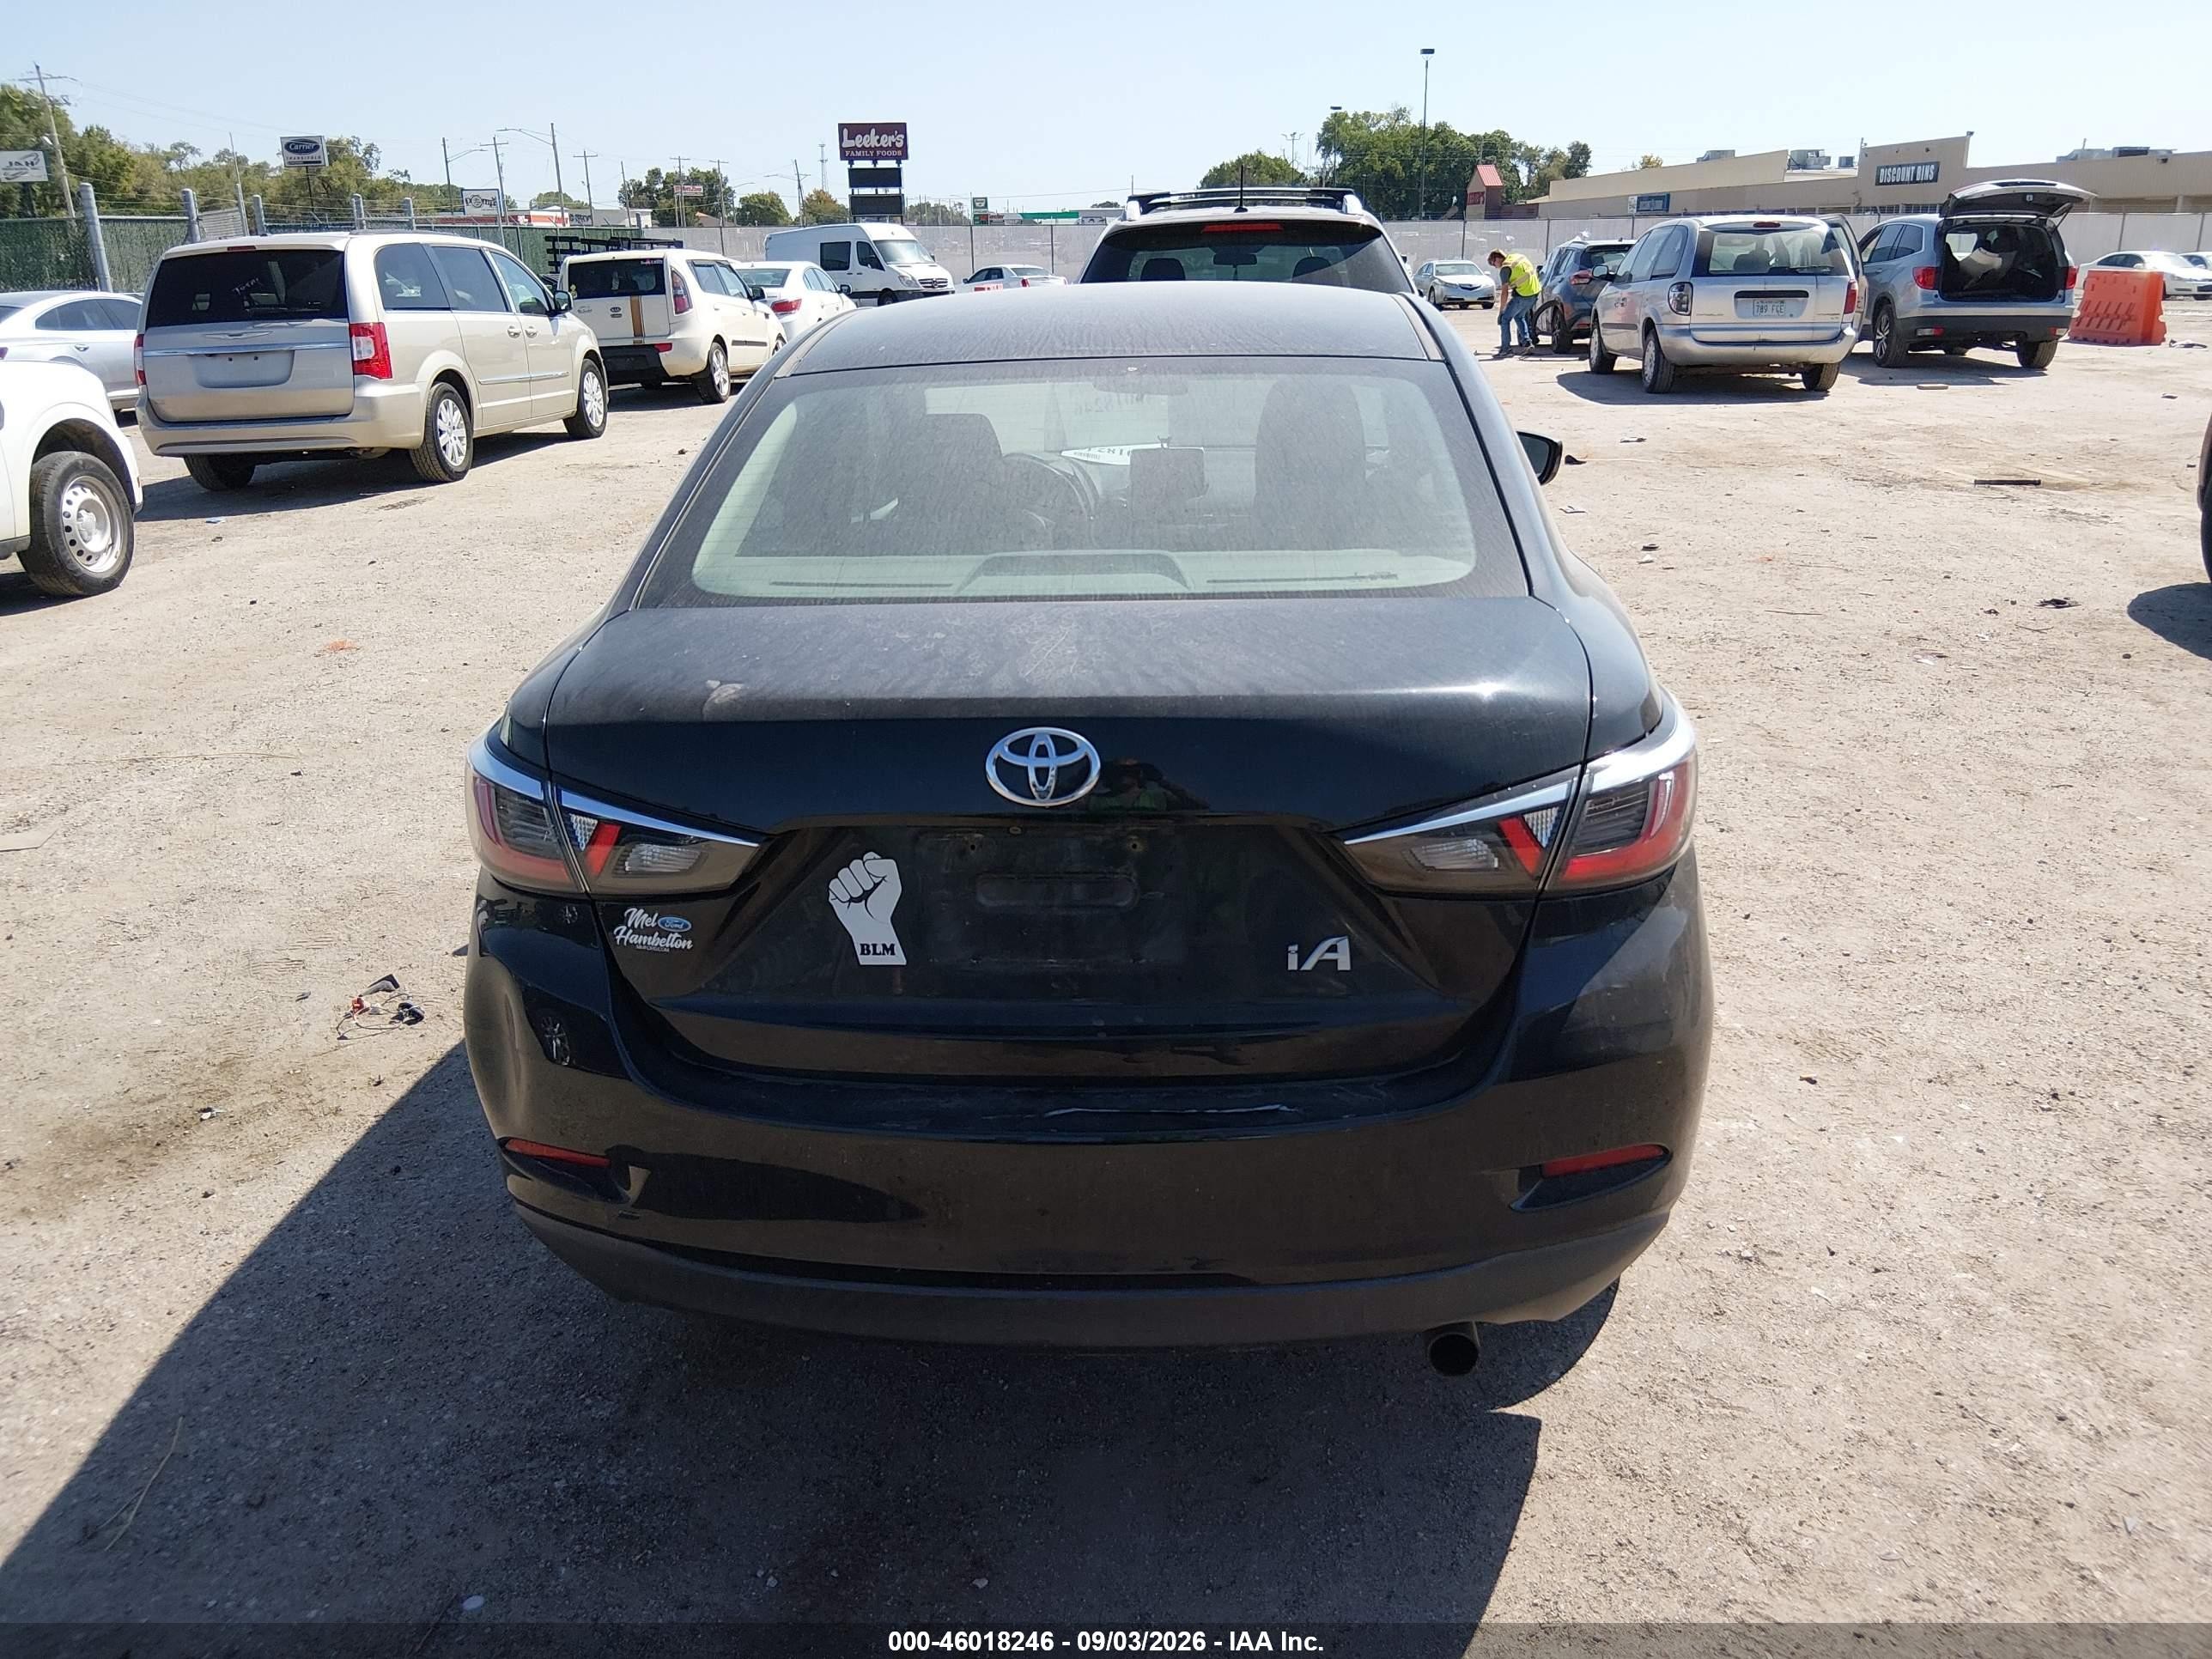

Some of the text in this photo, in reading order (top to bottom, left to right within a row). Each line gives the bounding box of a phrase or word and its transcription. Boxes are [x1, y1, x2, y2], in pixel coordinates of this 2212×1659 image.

[842, 128, 905, 149] Leeker's
[1879, 164, 1935, 183] DISCOUNT BINS
[624, 908, 659, 929] Mel
[613, 926, 694, 950] Hambelton
[860, 943, 896, 956] BLM
[1287, 936, 1352, 971] iA
